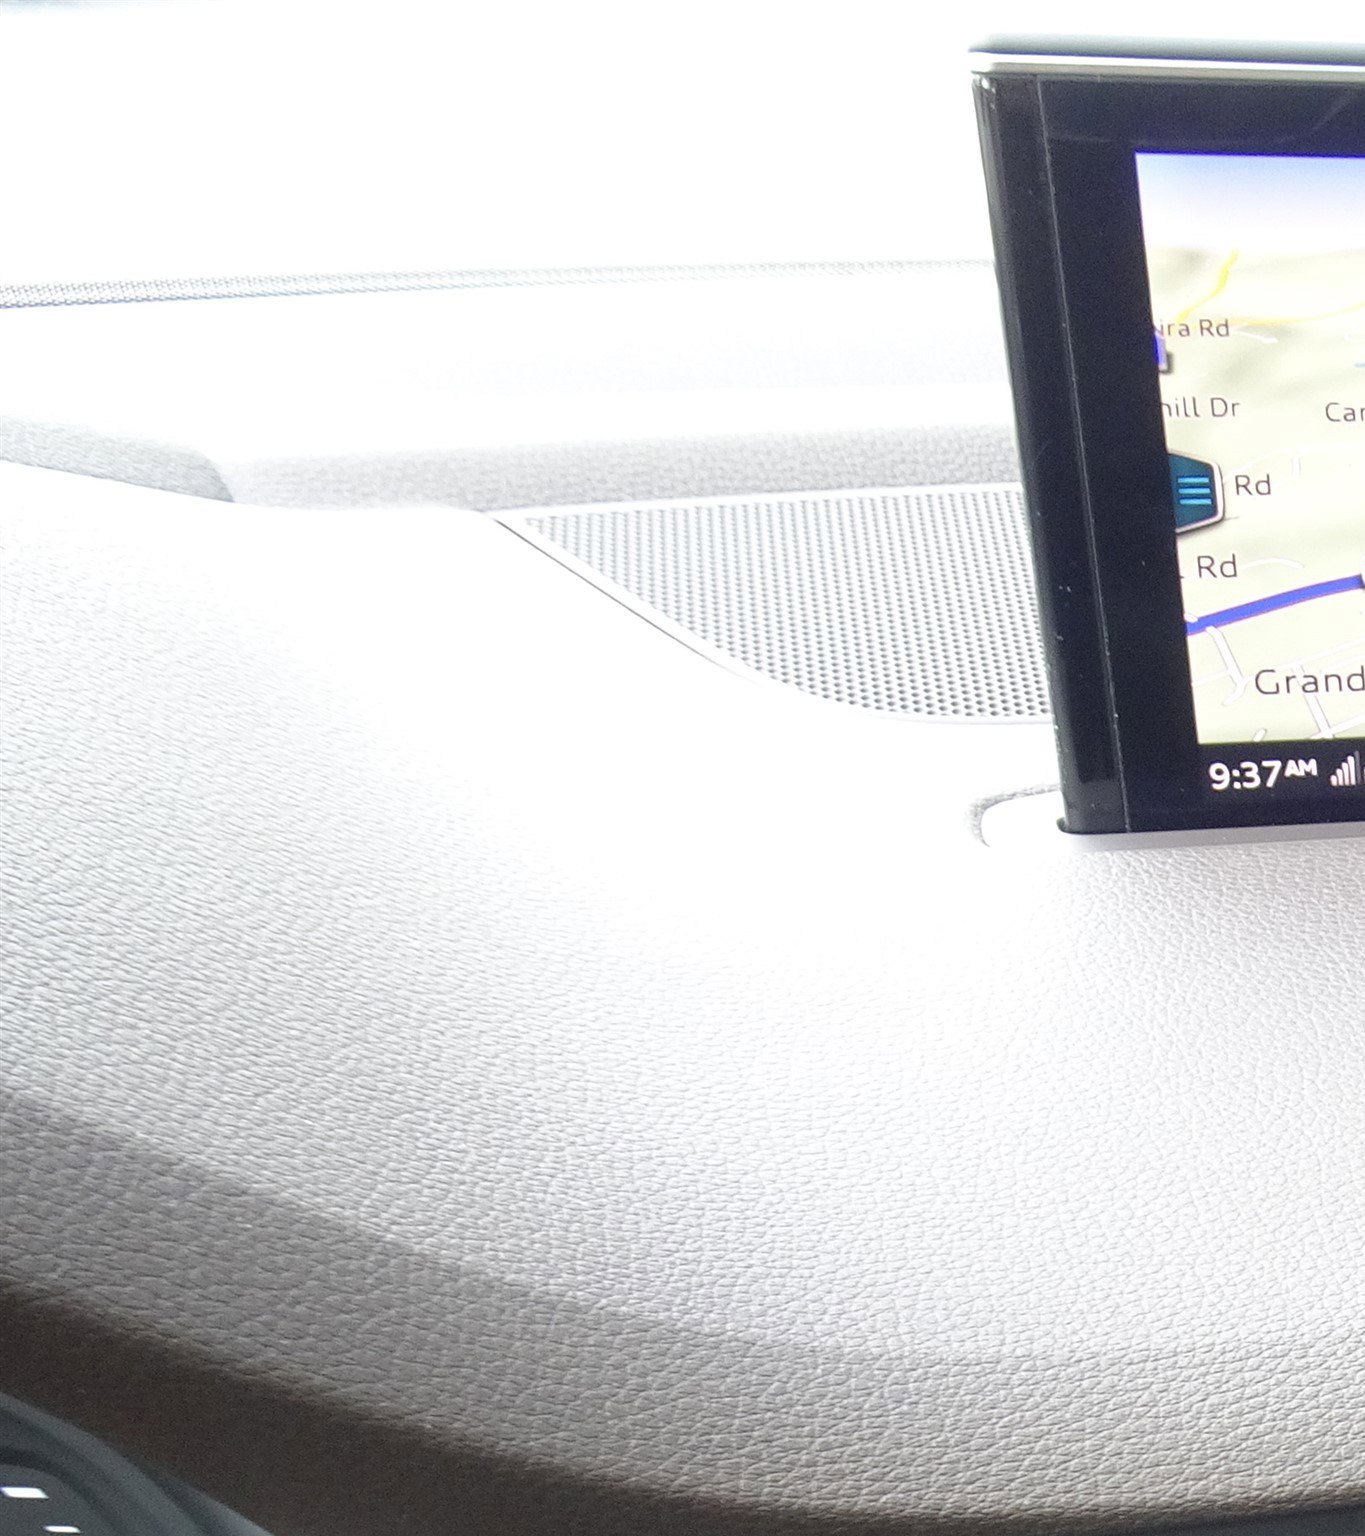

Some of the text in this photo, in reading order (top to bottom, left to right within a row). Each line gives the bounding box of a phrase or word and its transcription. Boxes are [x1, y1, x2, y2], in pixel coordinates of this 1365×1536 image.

[1199, 317, 1230, 338] Rd
[1210, 396, 1241, 418] Dr
[1235, 472, 1273, 496] Rd
[1197, 552, 1238, 579] Rd
